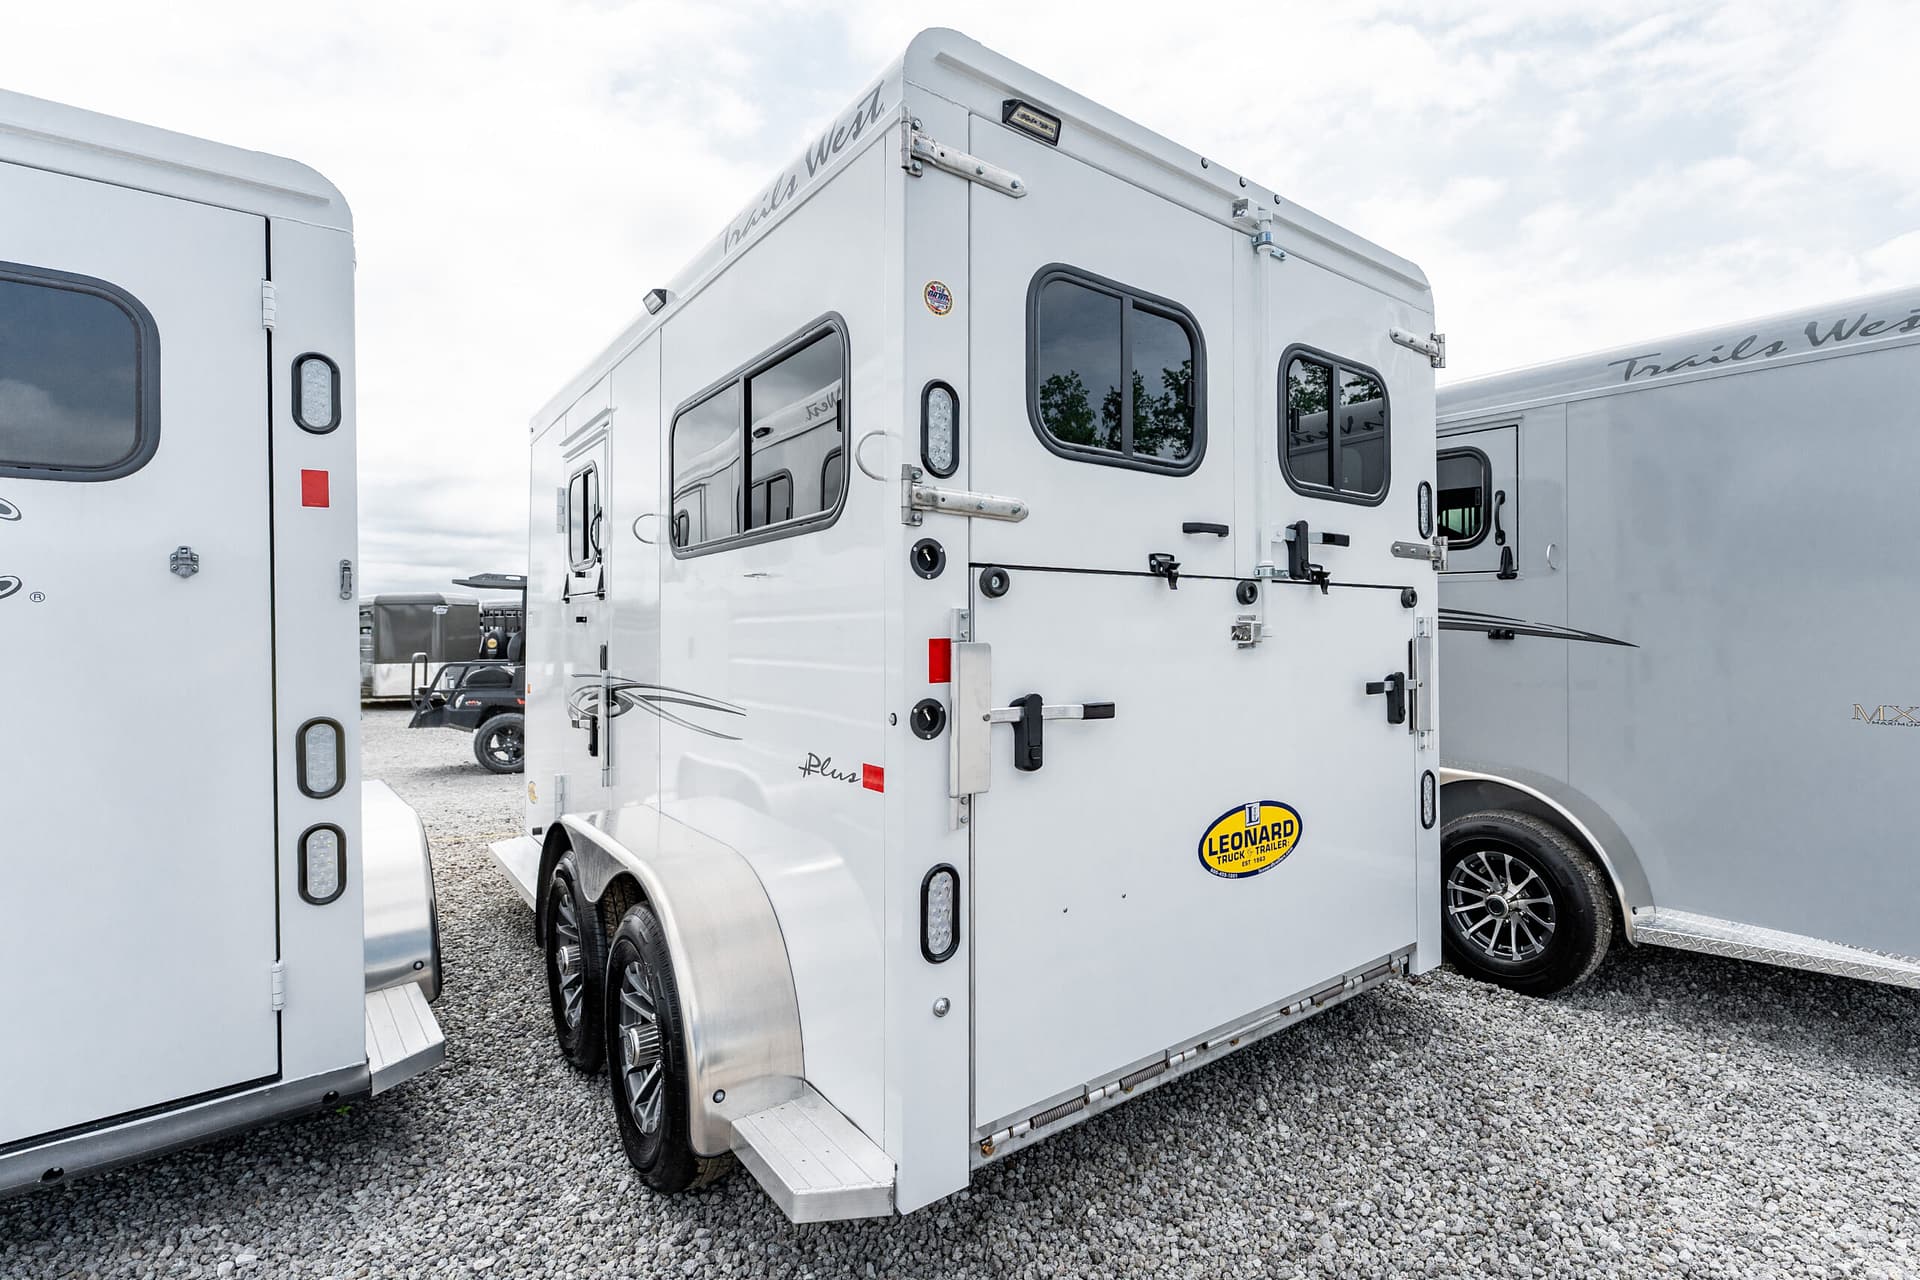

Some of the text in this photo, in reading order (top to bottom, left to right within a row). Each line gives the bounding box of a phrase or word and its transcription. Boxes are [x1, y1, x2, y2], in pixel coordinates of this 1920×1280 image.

[719, 80, 884, 255] Trails West
[1608, 334, 1787, 381] Trails
[798, 752, 861, 783] Plus
[1208, 819, 1294, 857] LEONARD
[1216, 850, 1245, 865] TRUCK
[1255, 839, 1287, 856] TRAILER
